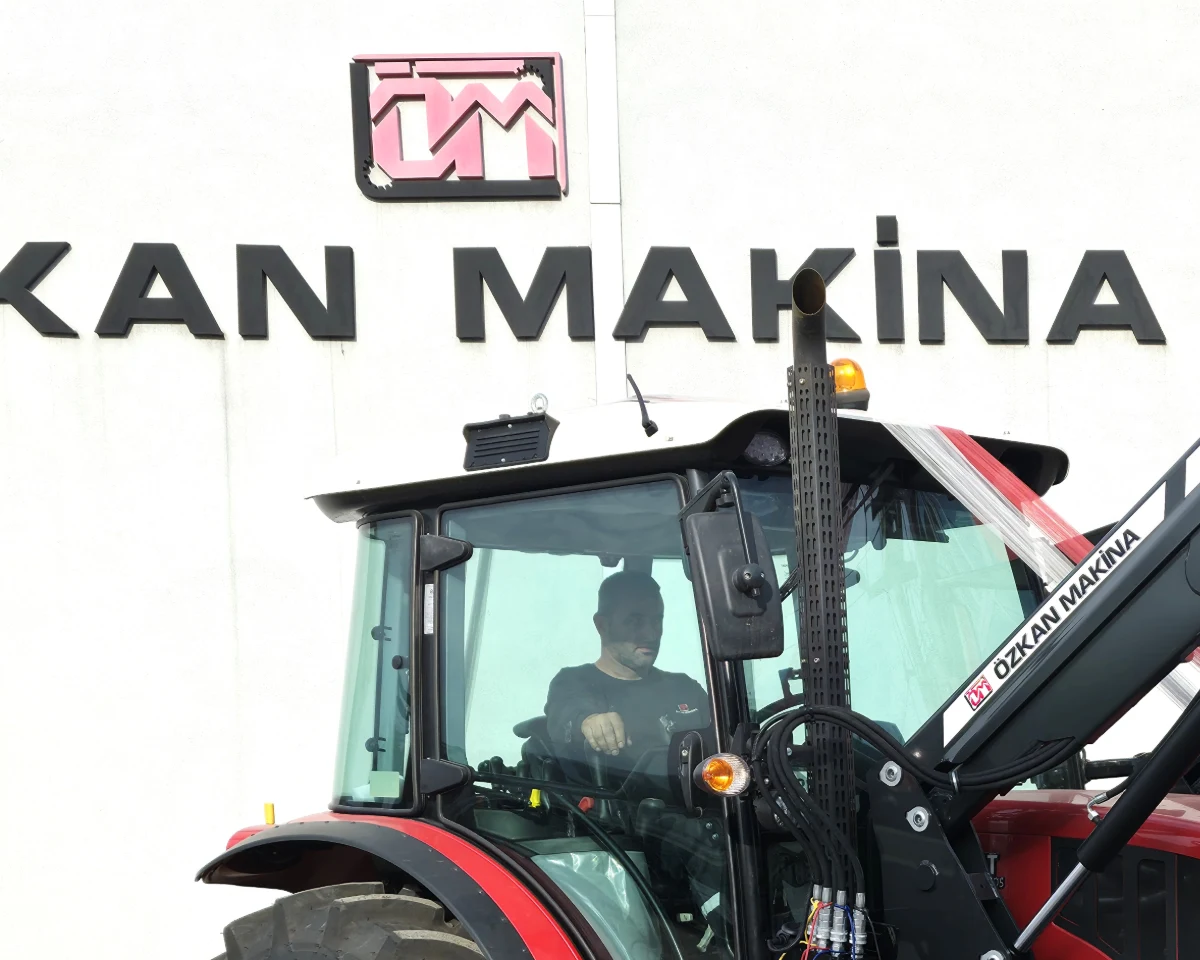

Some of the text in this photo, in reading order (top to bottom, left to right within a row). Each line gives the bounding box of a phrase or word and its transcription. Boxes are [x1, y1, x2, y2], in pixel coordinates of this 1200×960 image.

[452, 215, 1167, 345] MAKİNA
[993, 605, 1060, 680] ÖZKAN
[1058, 528, 1141, 612] MAKİNA
